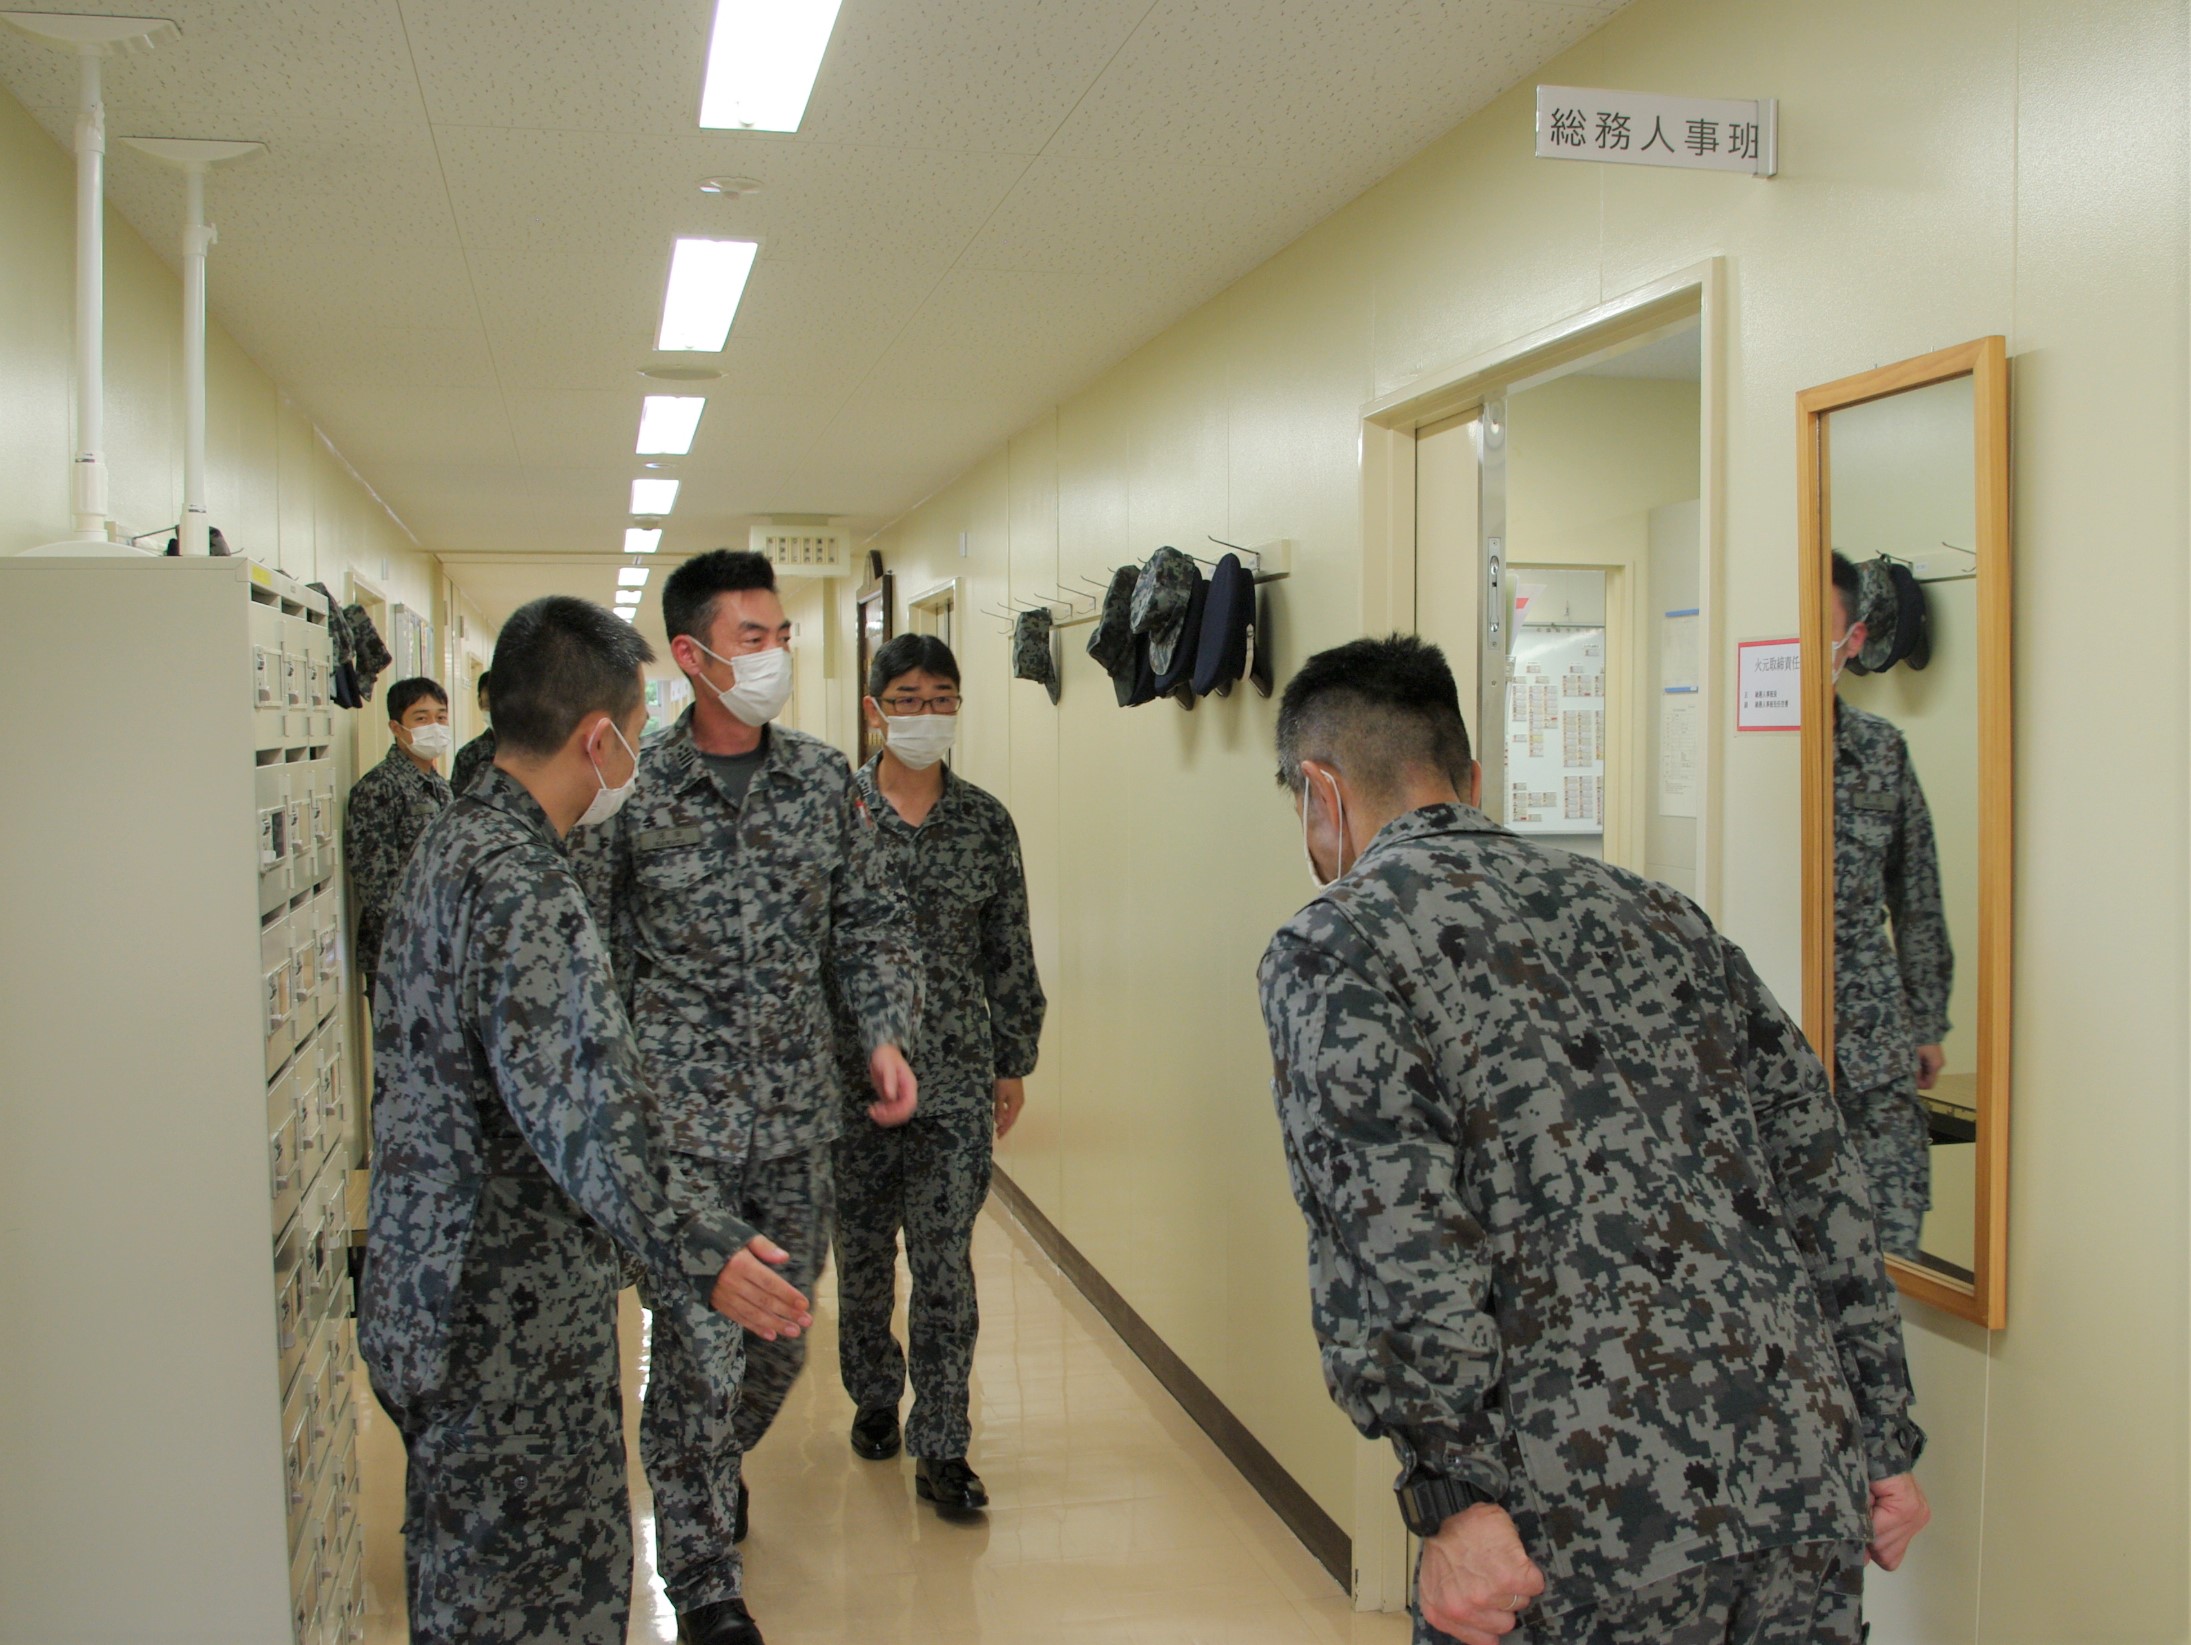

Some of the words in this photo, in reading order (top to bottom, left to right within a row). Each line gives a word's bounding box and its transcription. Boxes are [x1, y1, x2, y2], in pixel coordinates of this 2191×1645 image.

[1551, 108, 1758, 159] 総務人事班
